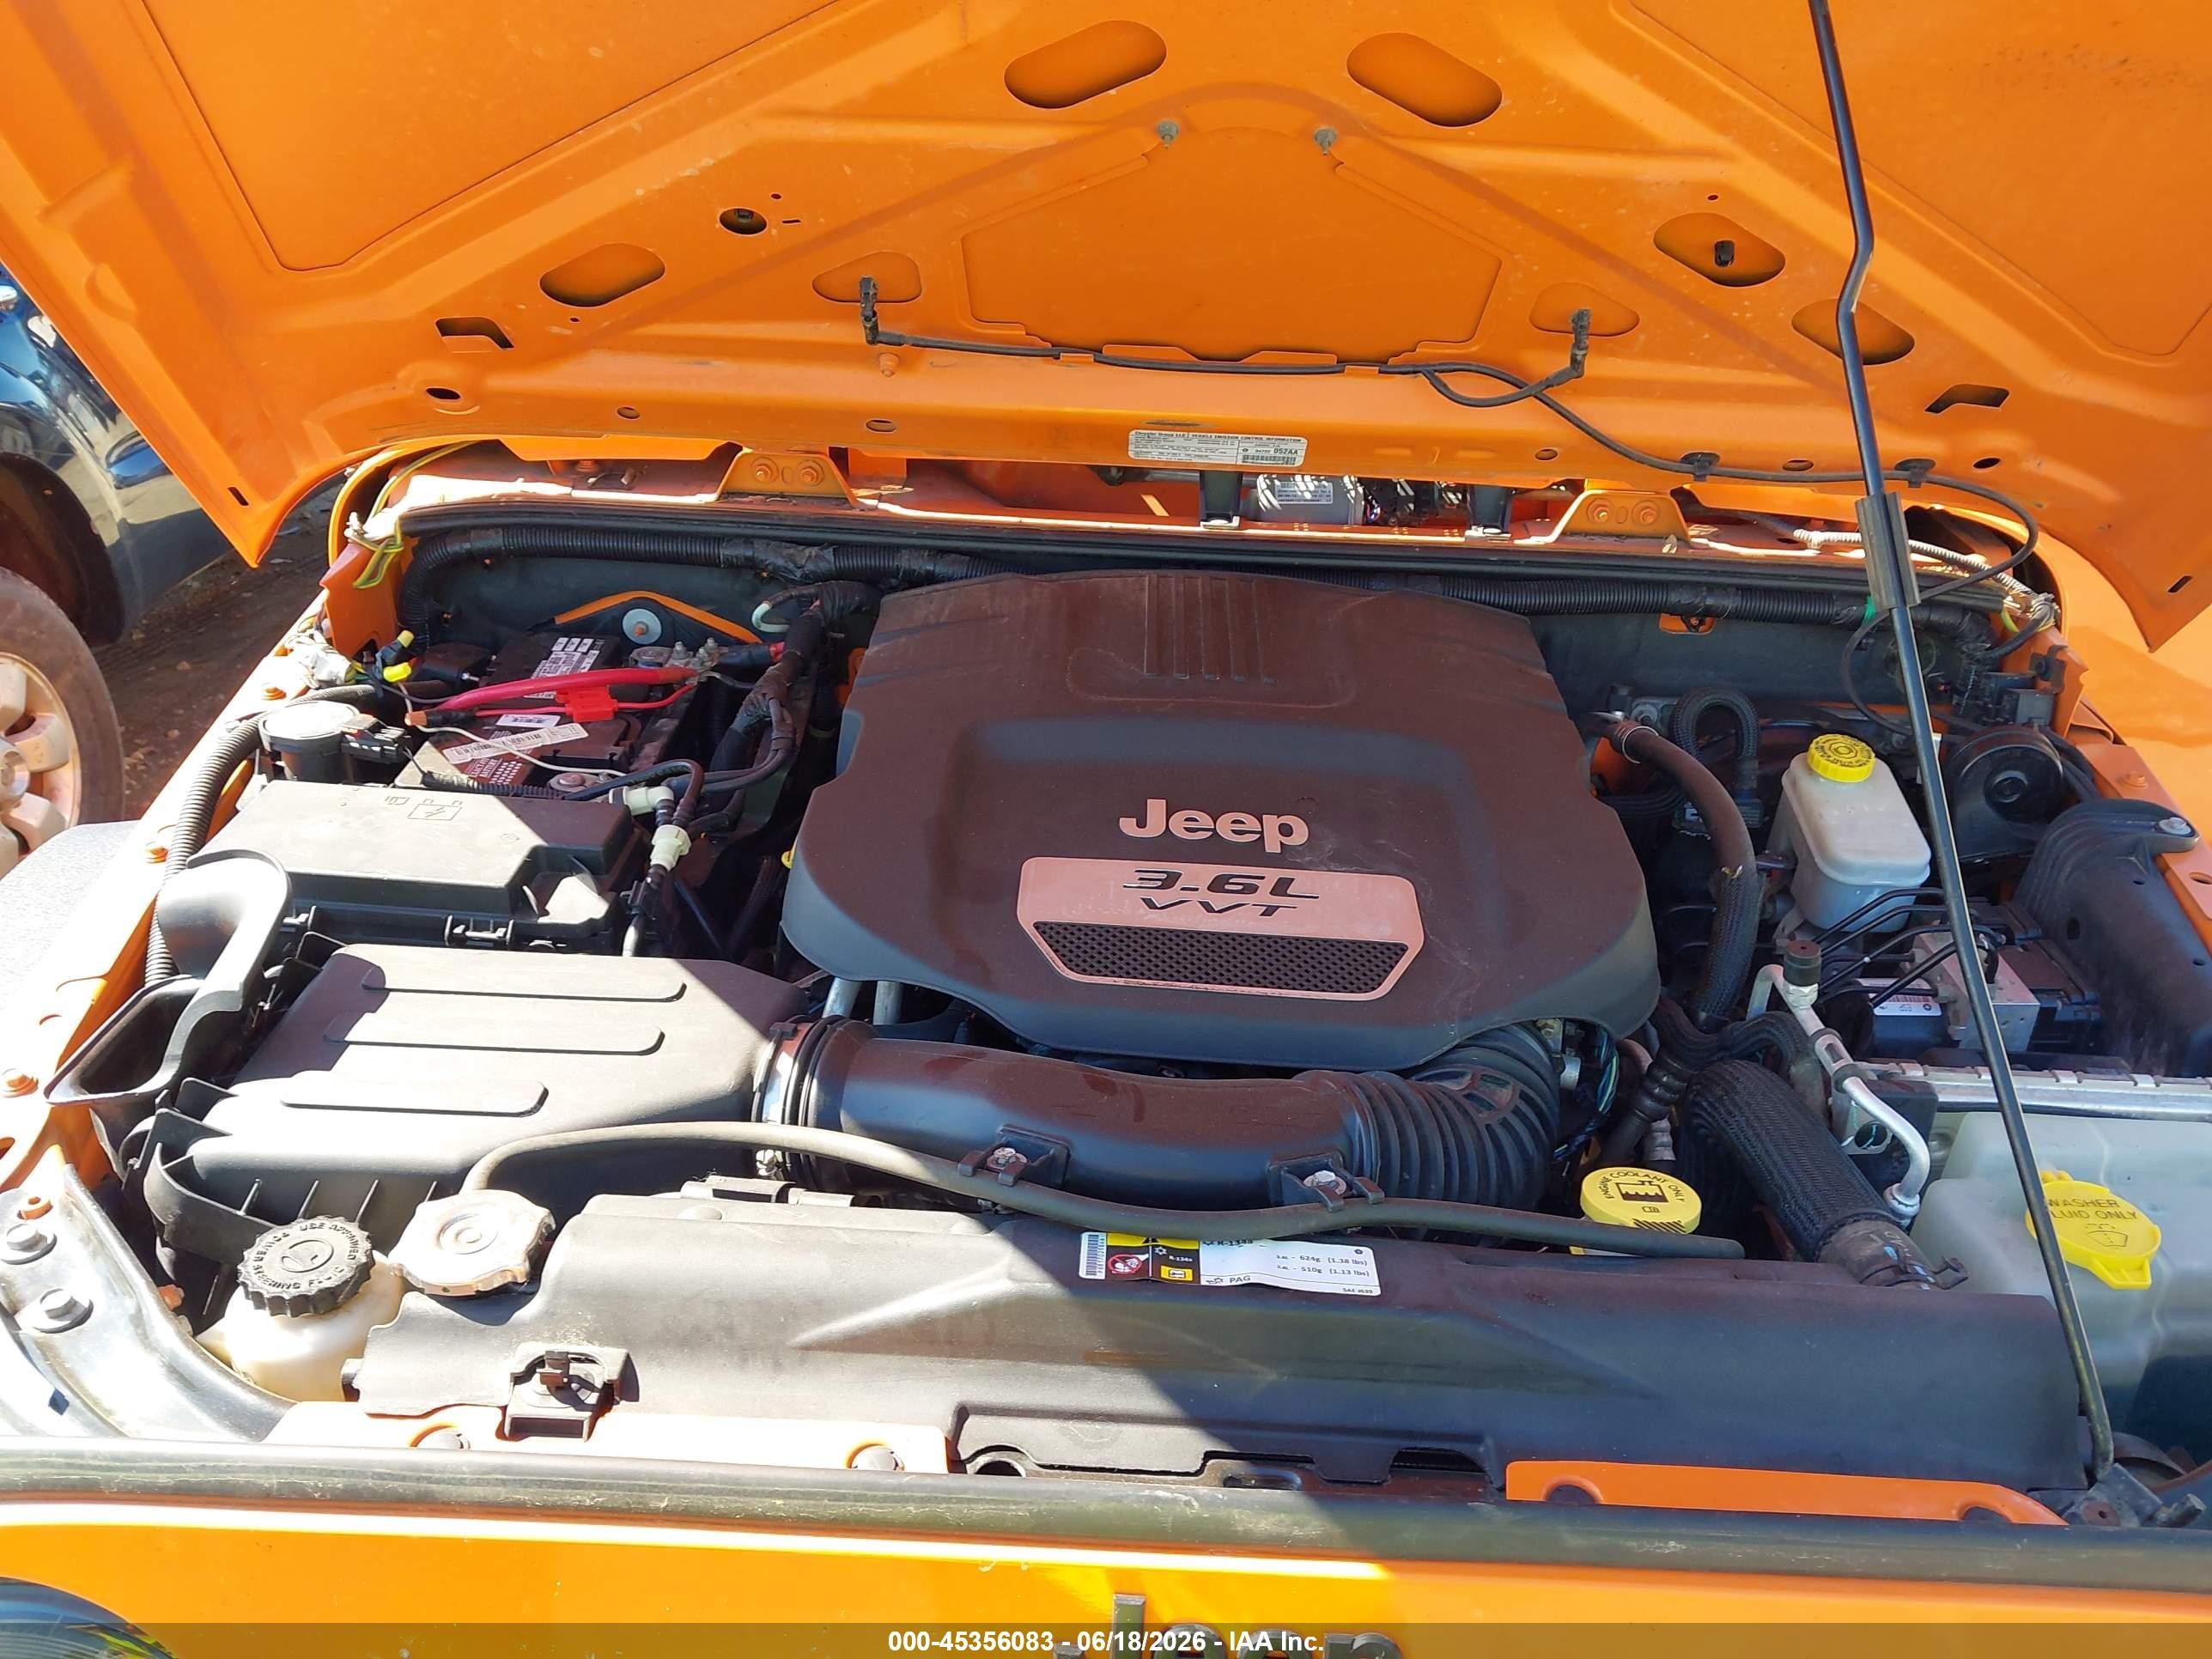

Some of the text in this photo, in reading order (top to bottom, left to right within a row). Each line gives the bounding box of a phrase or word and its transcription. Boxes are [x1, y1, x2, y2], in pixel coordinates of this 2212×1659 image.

[1273, 447, 1298, 456] 052AA
[1119, 798, 1310, 854] Jeep
[1122, 869, 1320, 900] 3.6L
[1139, 896, 1298, 917] VVT
[1598, 1170, 1686, 1202] ENGINE COOLANT ONLY
[2048, 1198, 2120, 1208] WASHER
[2051, 1210, 2137, 1219] LUID ONLY
[1299, 1255, 1322, 1263] 624g
[1229, 1275, 1251, 1284] PAG
